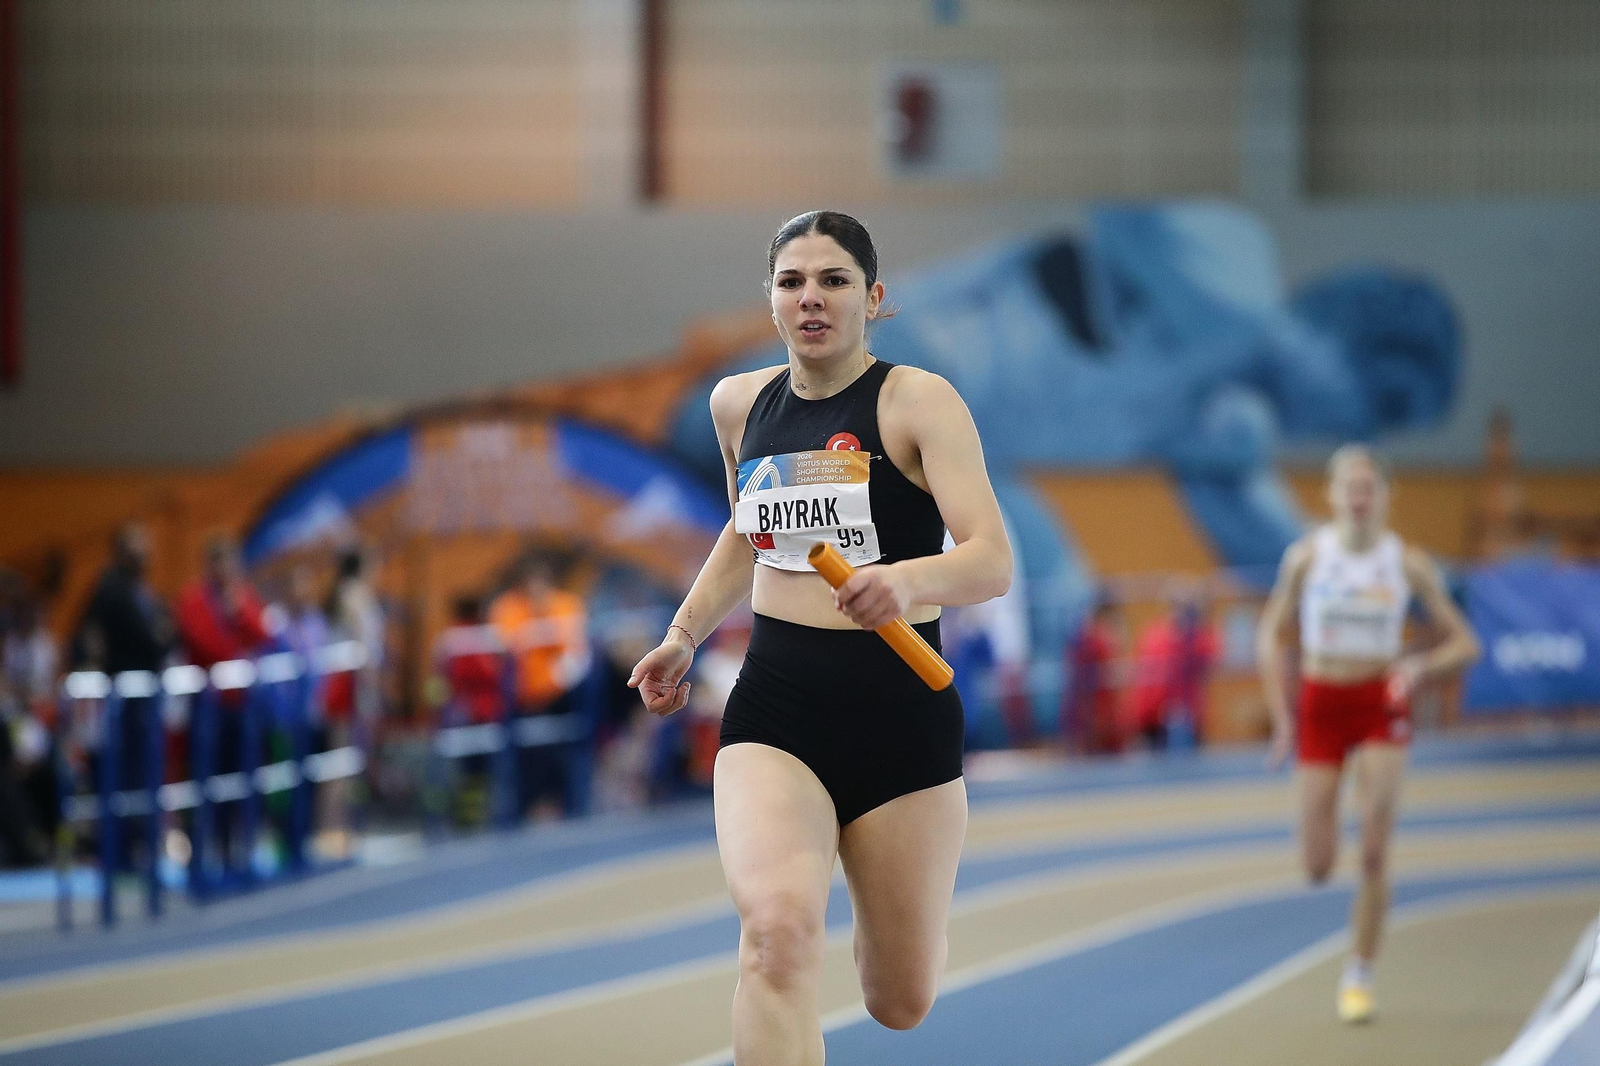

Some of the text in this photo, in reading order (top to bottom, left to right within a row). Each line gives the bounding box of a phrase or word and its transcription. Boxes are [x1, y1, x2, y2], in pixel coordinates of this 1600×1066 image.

[796, 468, 820, 476] SHORT
[796, 475, 852, 483] CHAMPIONSHIP
[758, 497, 840, 532] BAYRAK
[837, 528, 865, 548] 95
